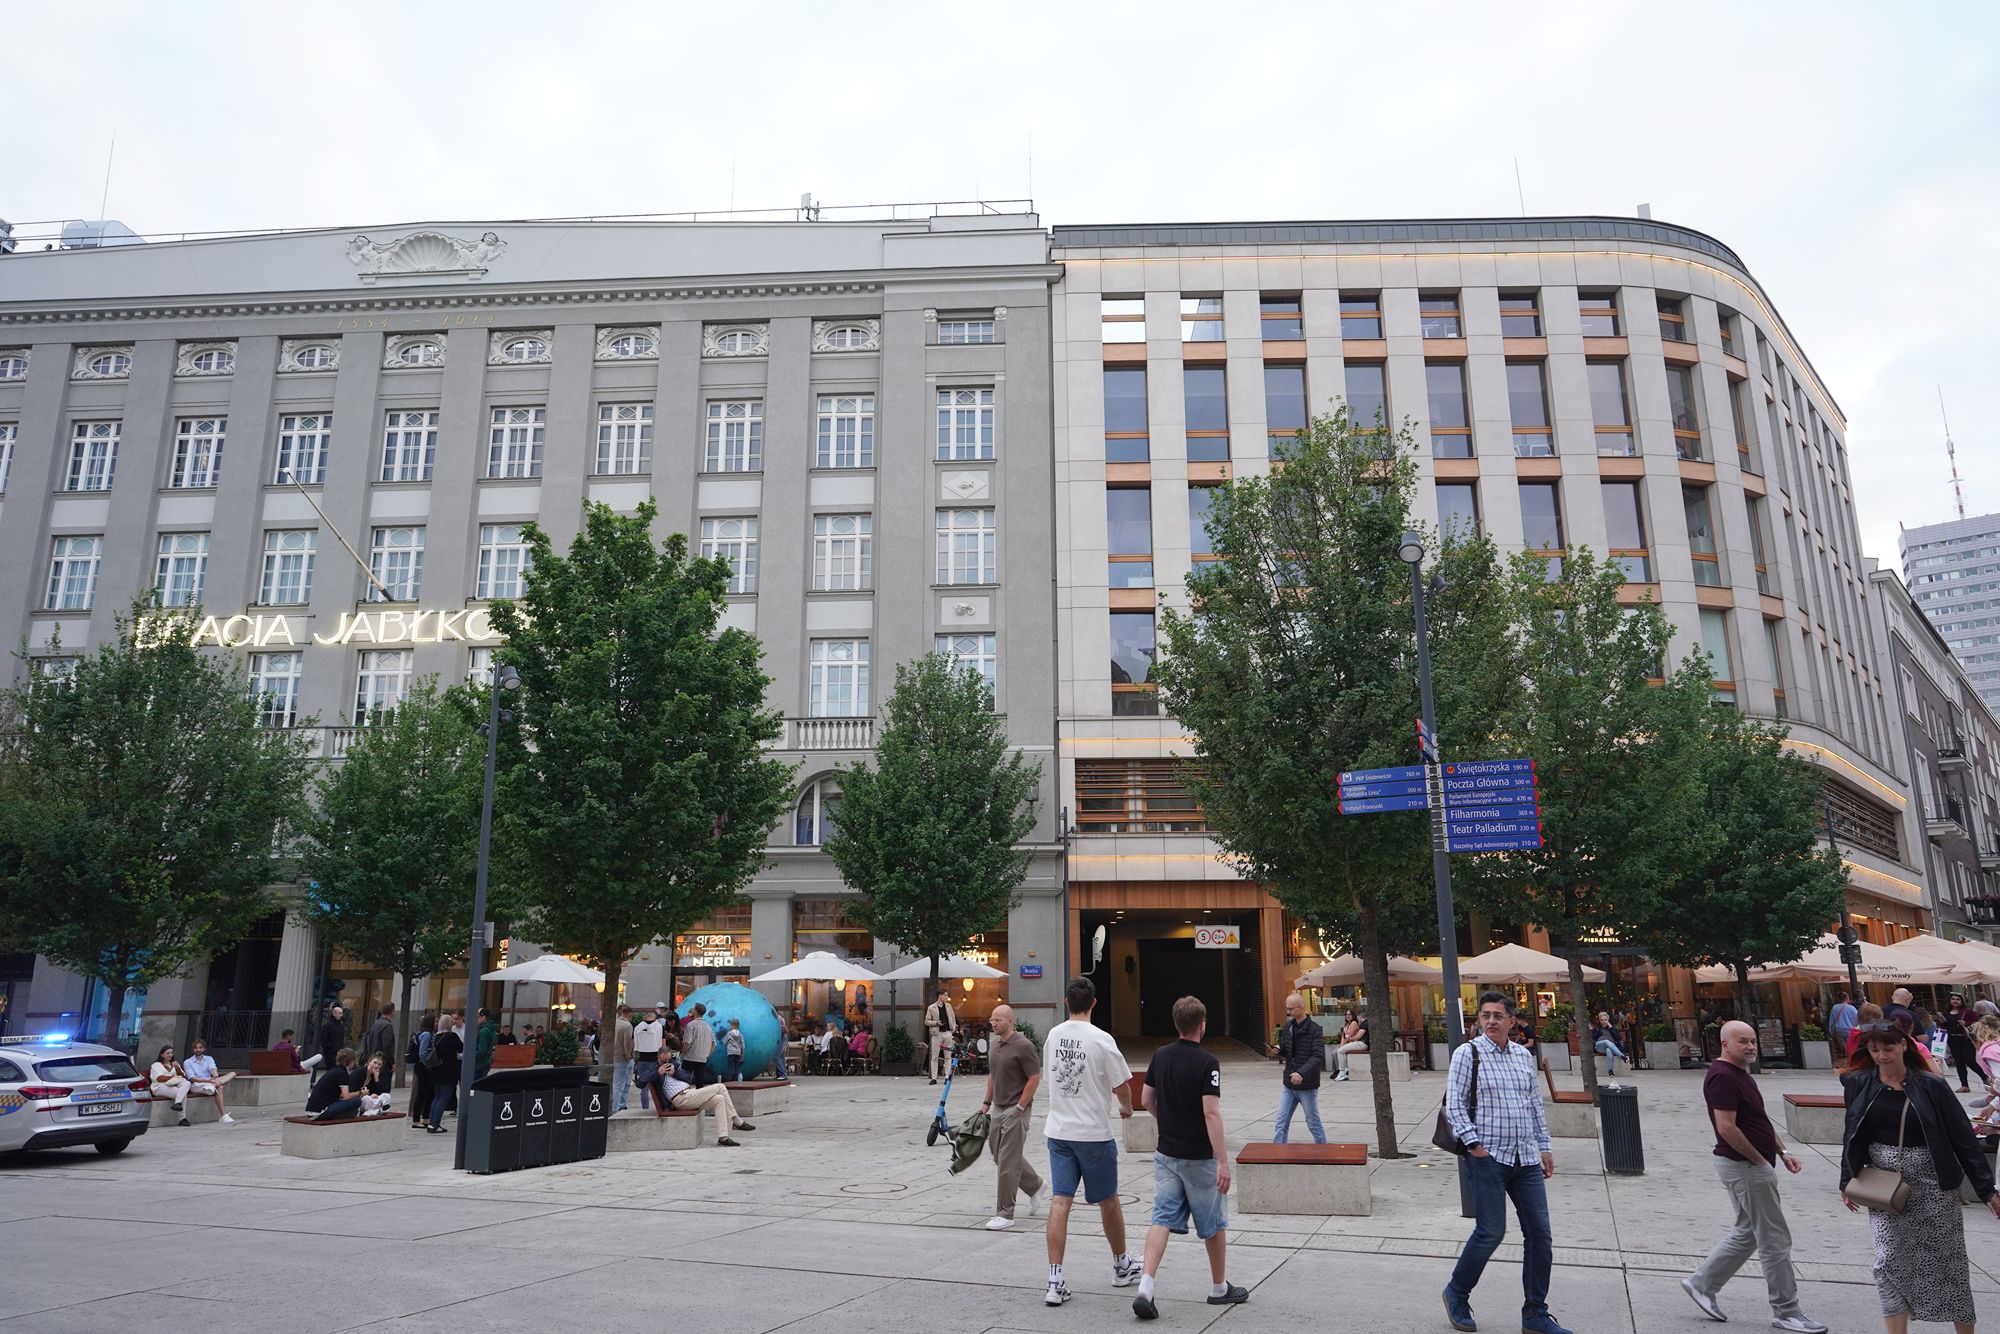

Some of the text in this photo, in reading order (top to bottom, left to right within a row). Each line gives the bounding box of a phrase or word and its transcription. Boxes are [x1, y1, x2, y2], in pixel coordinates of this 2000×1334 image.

[1457, 762, 1509, 775] Świętokrzyska
[1447, 780, 1474, 789] Poczta
[1476, 778, 1509, 787] Główna
[1450, 808, 1500, 819] Filharmonia
[1452, 824, 1473, 834] Teatr
[1475, 822, 1517, 833] Palladium
[696, 934, 731, 948] green
[1201, 933, 1206, 941] 5
[692, 956, 734, 967] NERO
[1060, 1038, 1083, 1050] BLUE
[1055, 1049, 1086, 1061] INDIGO
[1210, 1070, 1220, 1087] 3
